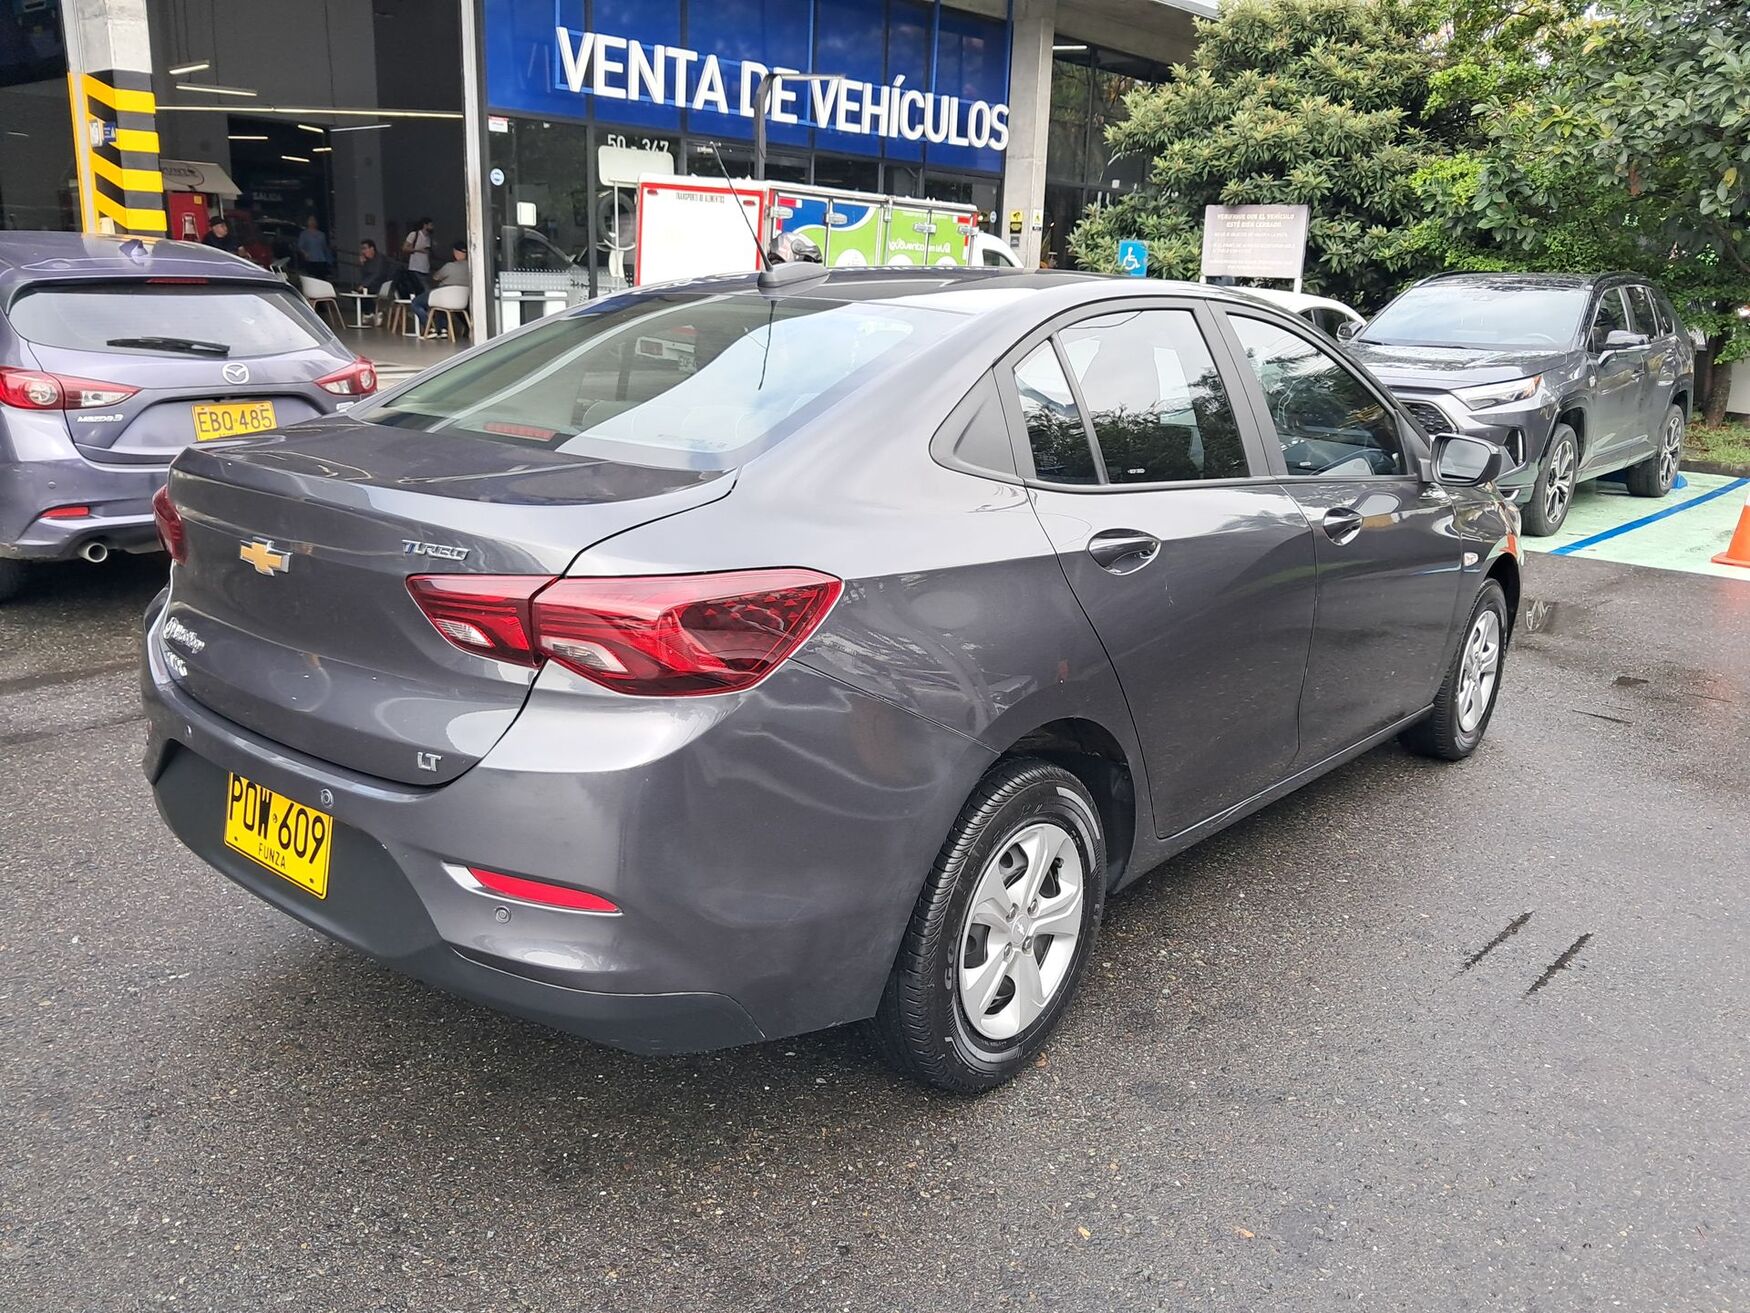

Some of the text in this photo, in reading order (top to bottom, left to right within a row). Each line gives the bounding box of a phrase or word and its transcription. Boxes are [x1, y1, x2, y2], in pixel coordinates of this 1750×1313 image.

[555, 26, 1010, 151] VENTA DE VEHÍCULOS
[197, 409, 272, 433] EBQ 485
[401, 539, 471, 560] TURBO
[417, 751, 442, 772] LT
[229, 773, 326, 864] POW 609
[258, 842, 286, 870] FUNZA
